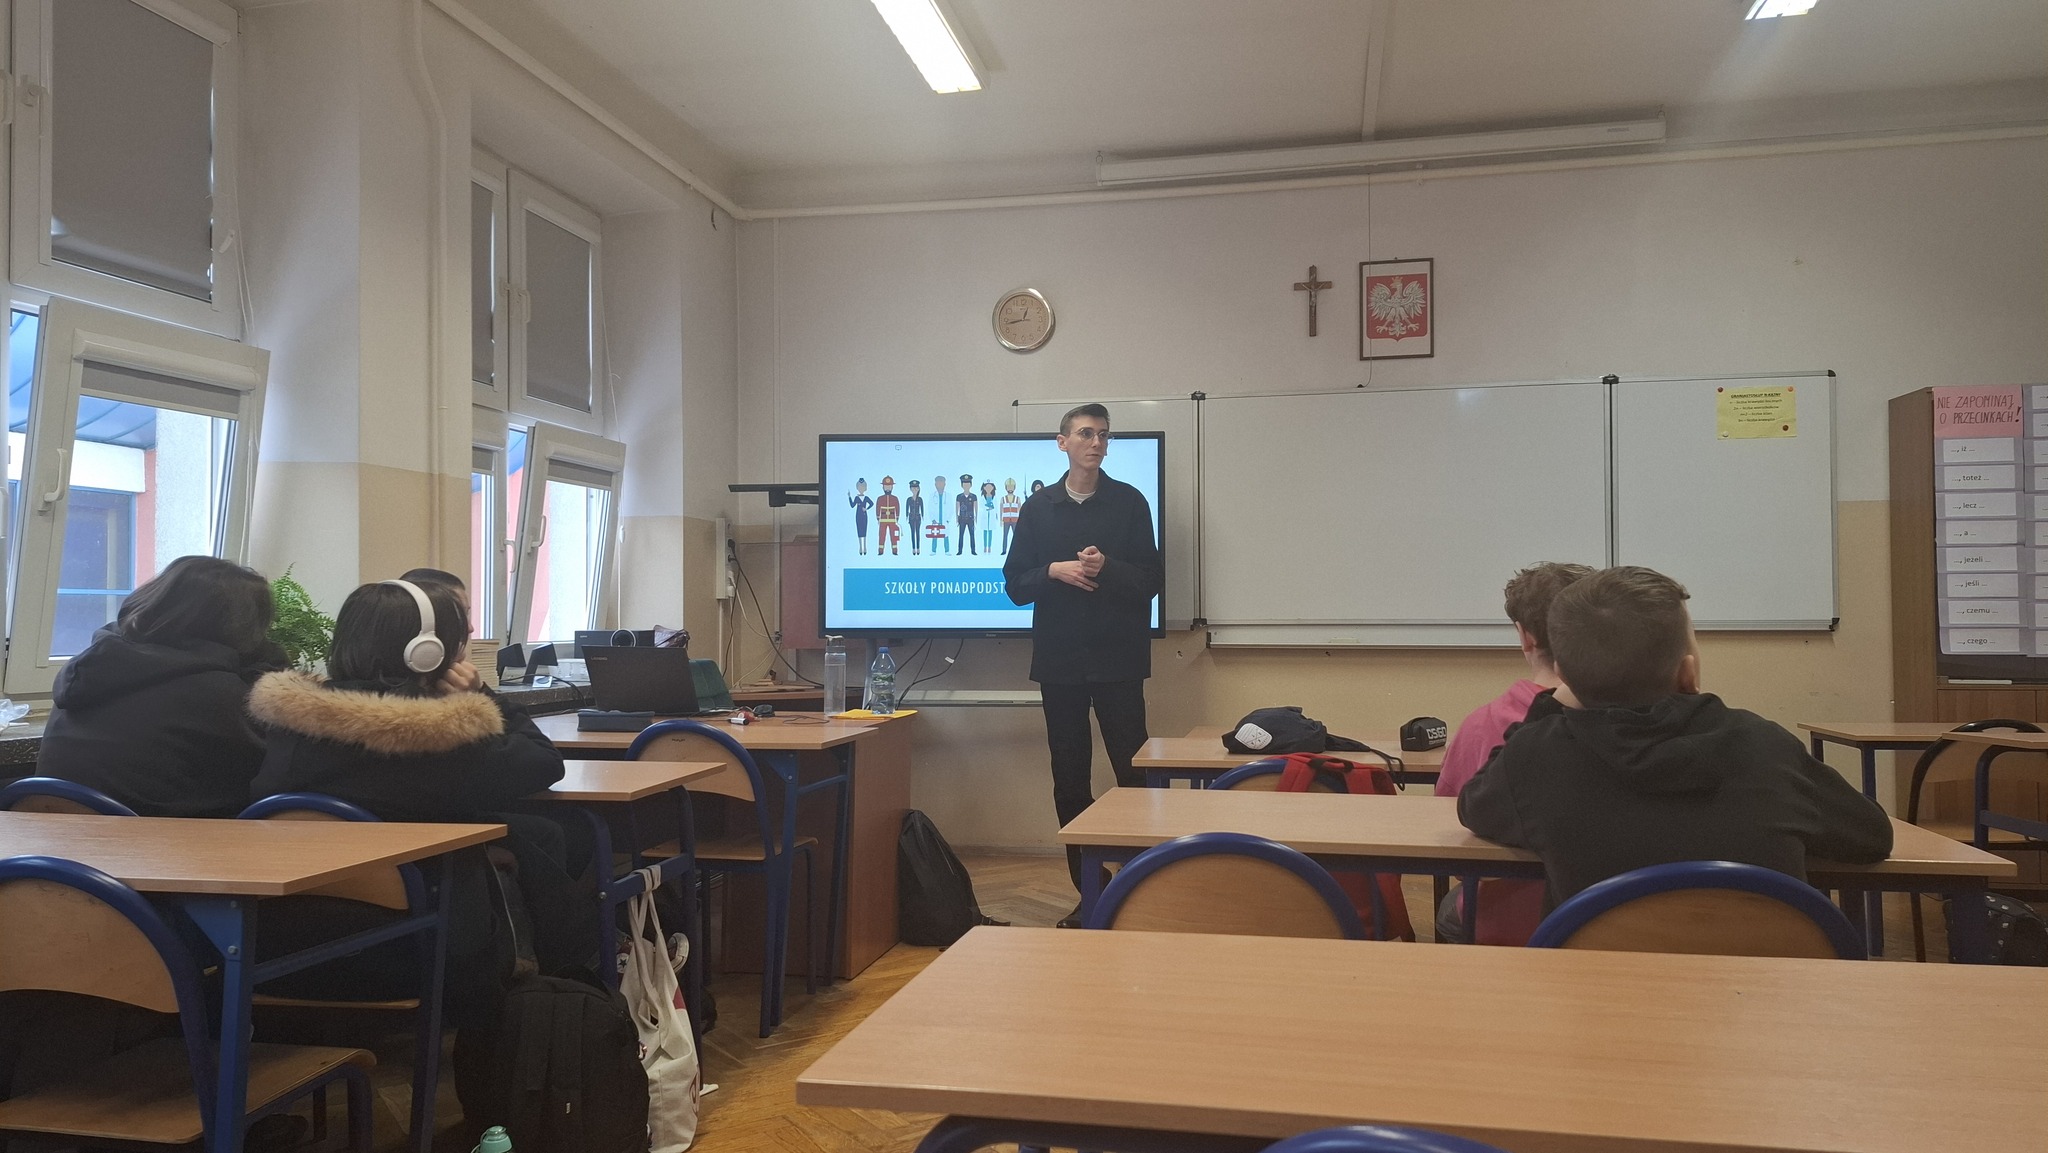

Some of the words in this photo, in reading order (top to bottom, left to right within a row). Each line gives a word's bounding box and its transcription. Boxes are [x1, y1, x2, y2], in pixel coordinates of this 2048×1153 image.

[1936, 396, 1951, 410] NIE
[1955, 394, 2015, 410] ZAPOMINAJ
[1939, 412, 1947, 425] O
[884, 581, 926, 594] SZKOŁY
[1965, 579, 1980, 588] jeśli
[1967, 638, 1988, 646] czego
